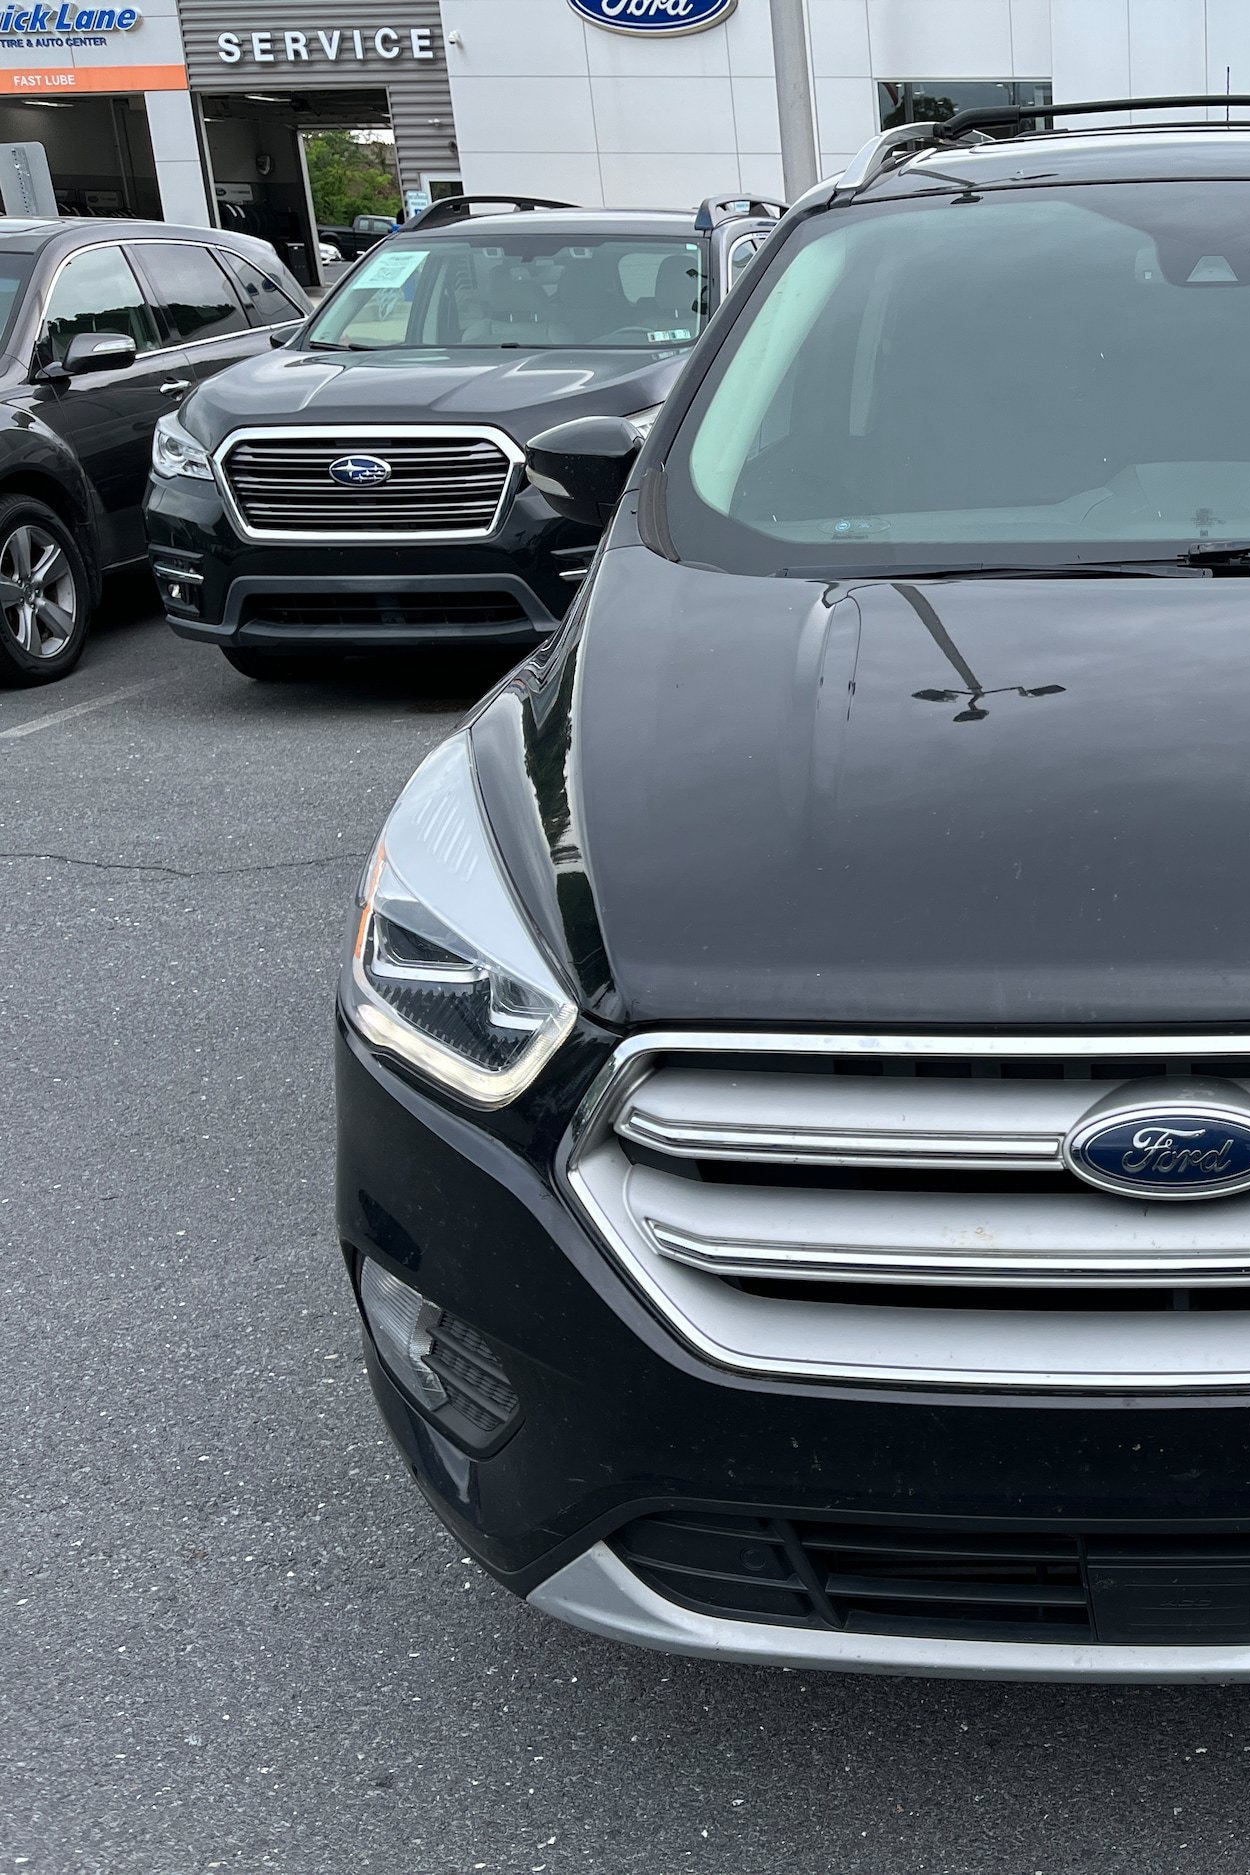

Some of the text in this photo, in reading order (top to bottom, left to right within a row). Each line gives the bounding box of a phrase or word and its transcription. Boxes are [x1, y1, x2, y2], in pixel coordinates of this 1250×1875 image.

[0, 3, 138, 31] ick Lane
[0, 37, 107, 48] TIRE & AUTO CENTER
[217, 27, 434, 63] SERVICE
[13, 75, 76, 87] FAST LUBE
[1121, 1127, 1235, 1173] Ford
